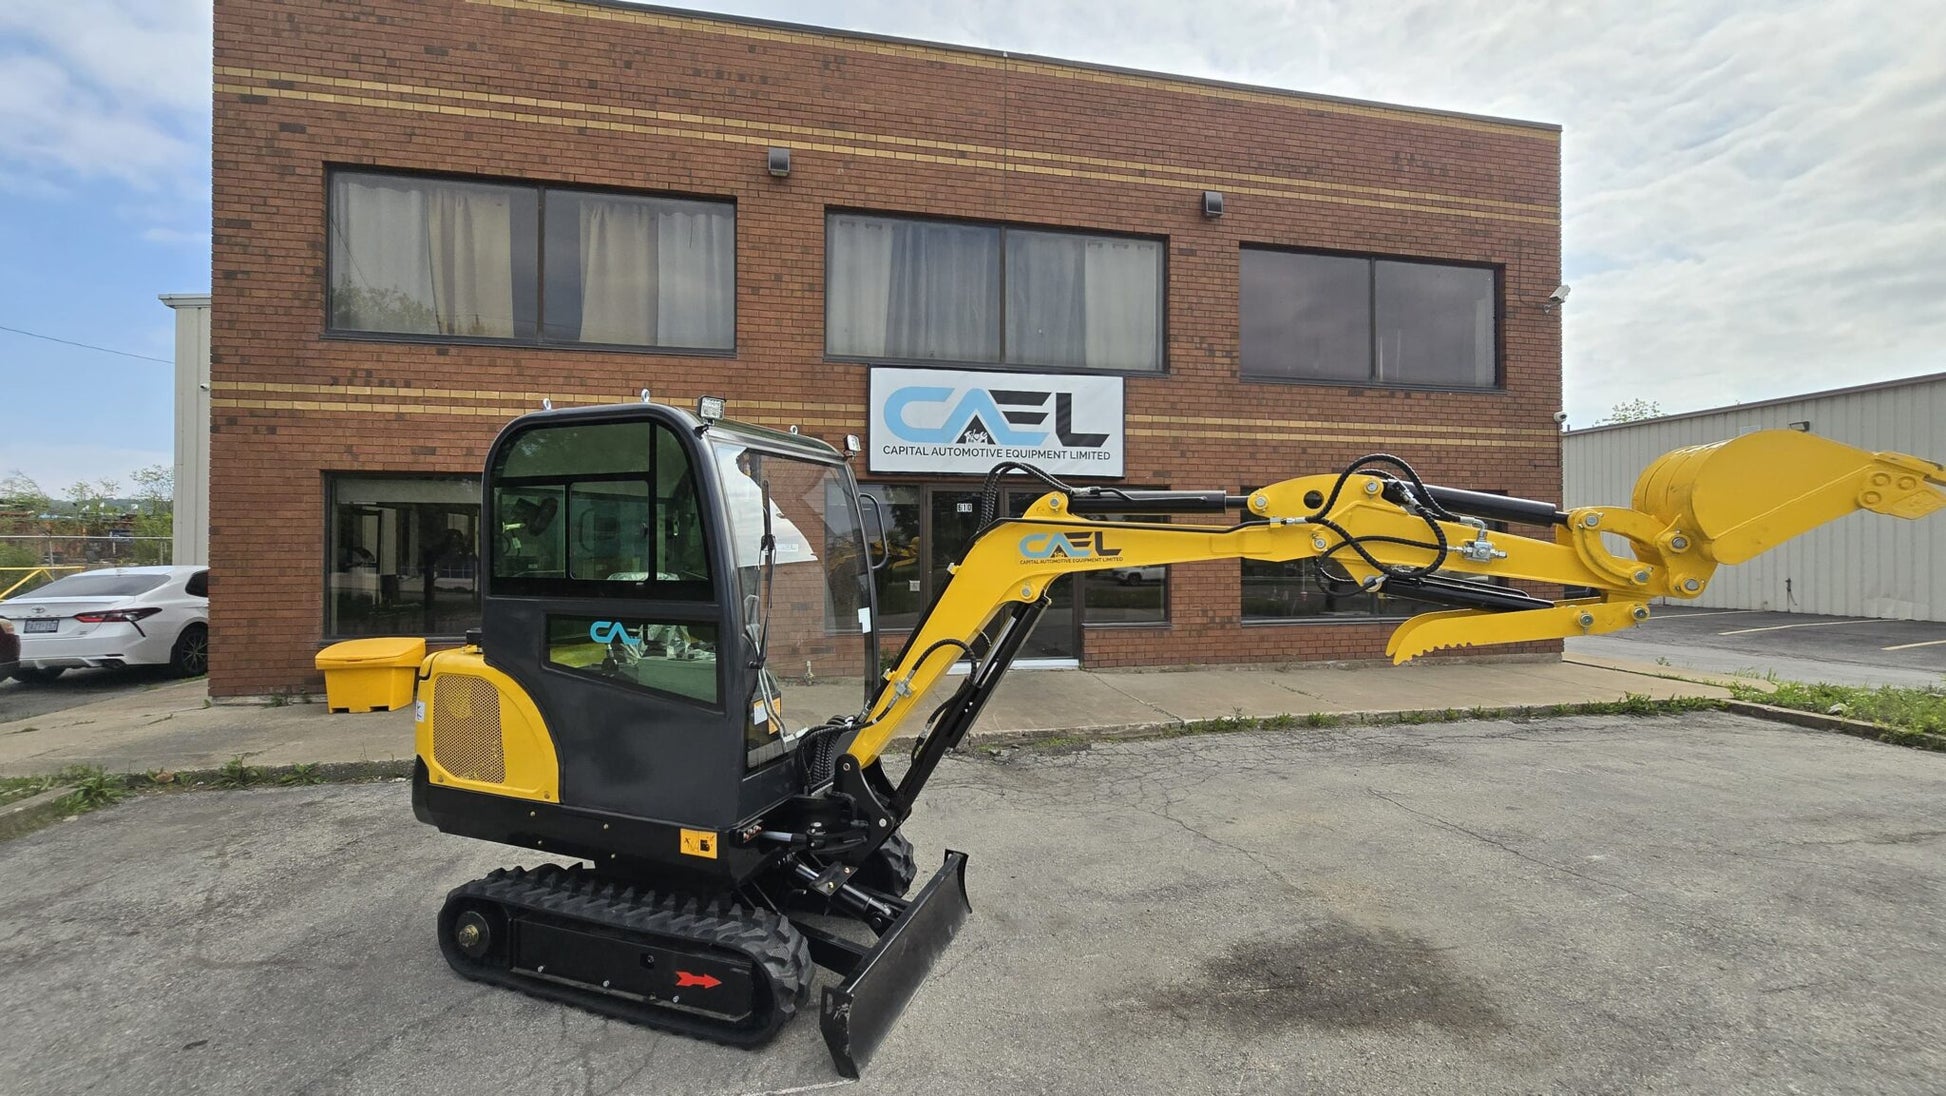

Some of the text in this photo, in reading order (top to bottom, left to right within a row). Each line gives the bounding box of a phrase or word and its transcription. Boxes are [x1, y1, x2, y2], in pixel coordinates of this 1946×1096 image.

[883, 386, 1110, 448] CAEL
[883, 445, 1111, 461] CAPITAL AUTOMOTIVE EQUIPMENT LIMITED
[1018, 531, 1122, 558] CAEL
